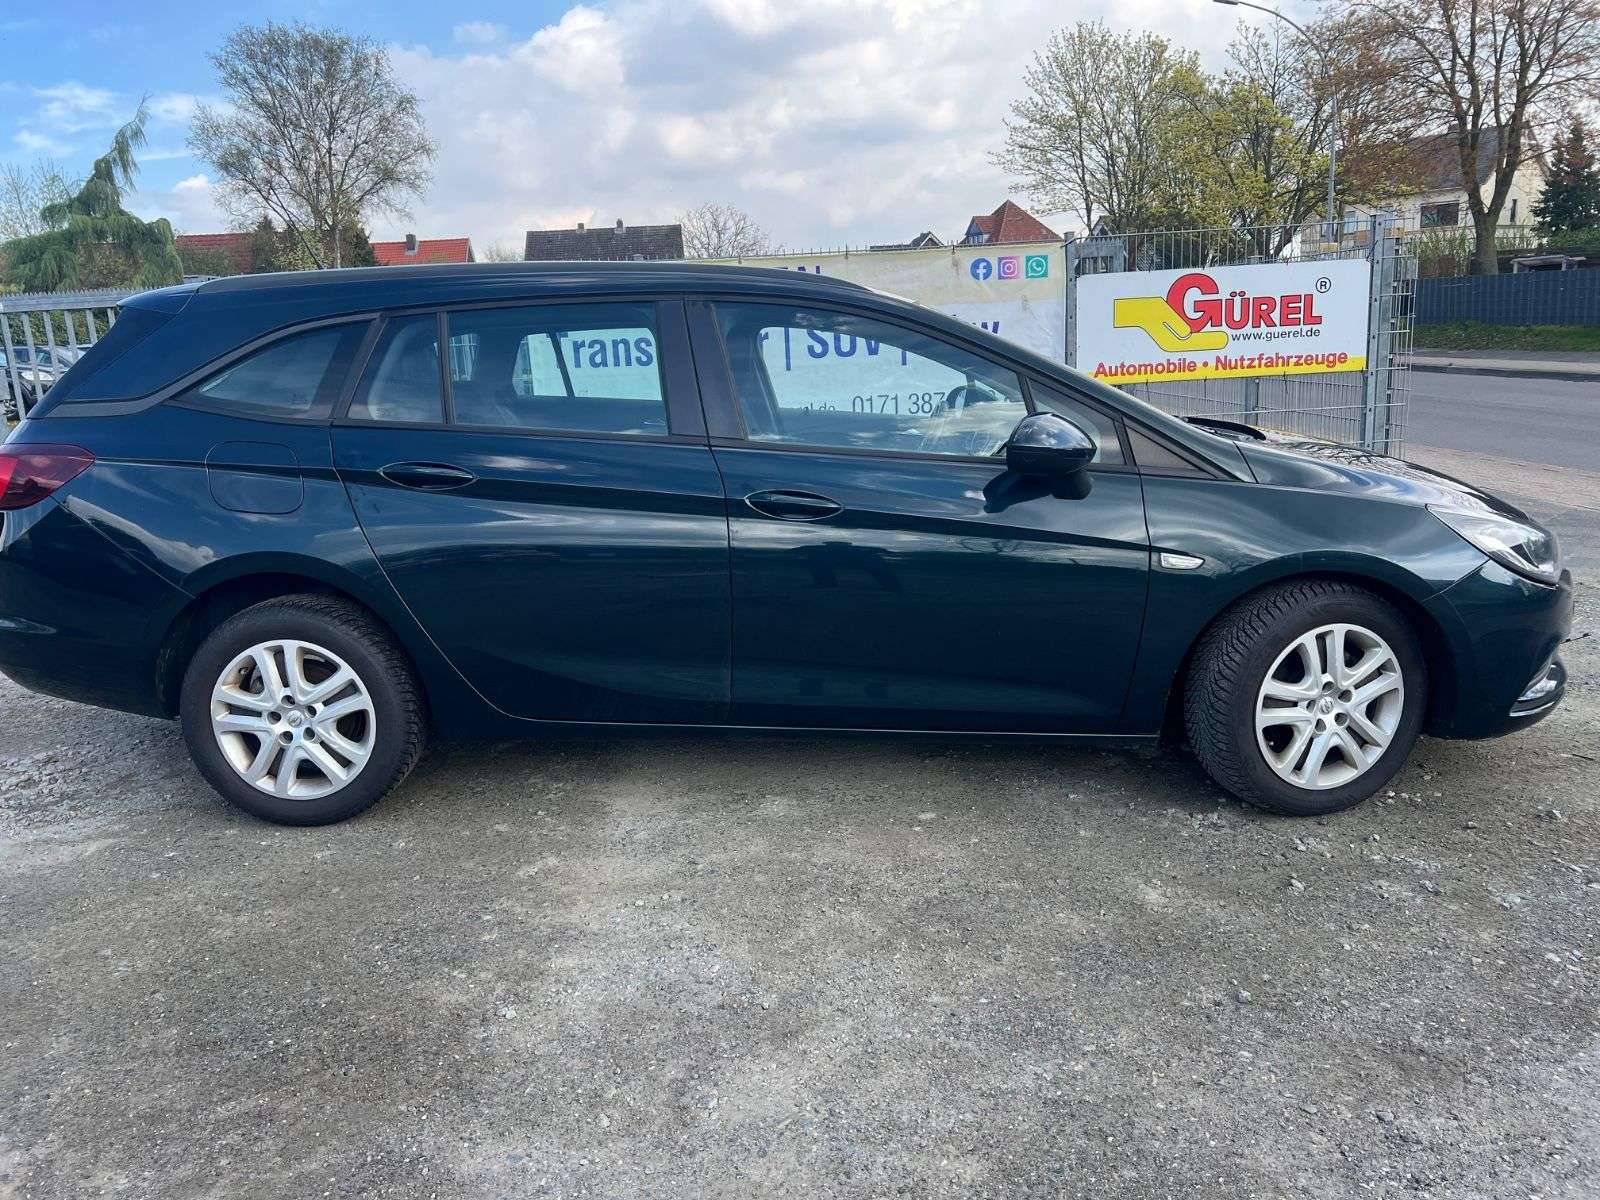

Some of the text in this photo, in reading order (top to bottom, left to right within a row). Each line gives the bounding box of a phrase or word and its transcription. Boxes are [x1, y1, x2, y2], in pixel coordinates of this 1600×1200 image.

[1167, 273, 1323, 333] GÜREL
[1231, 328, 1321, 342] www.guerel.de
[1094, 352, 1348, 378] Automobile Nutzfahrzeuge
[852, 394, 899, 415] 0171
